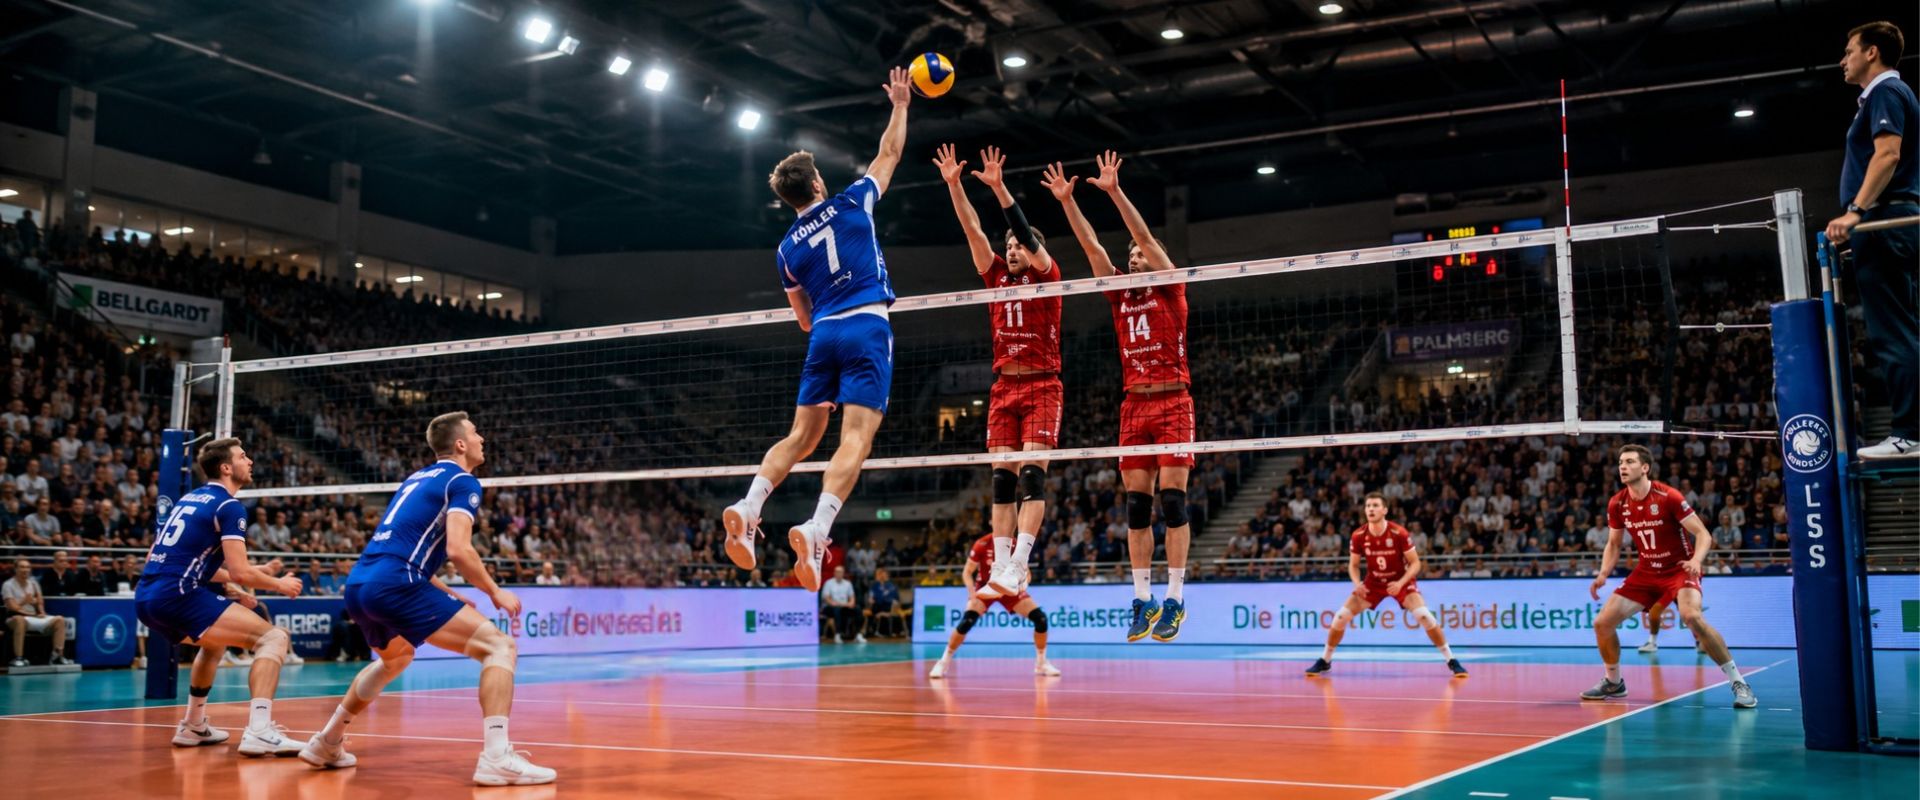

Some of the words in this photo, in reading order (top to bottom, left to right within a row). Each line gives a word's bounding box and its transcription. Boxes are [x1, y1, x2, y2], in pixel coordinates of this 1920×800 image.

[808, 225, 841, 275] 7
[97, 290, 210, 323] BELLGARDT
[1004, 301, 1024, 328] 11
[1127, 313, 1151, 344] 14
[1412, 329, 1510, 350] PALMBERG
[383, 481, 420, 525] 1
[156, 505, 197, 547] 15
[1637, 529, 1656, 550] 17
[1376, 556, 1387, 571] 9
[758, 611, 812, 628] PALMBERG
[1233, 604, 1272, 630] Die
